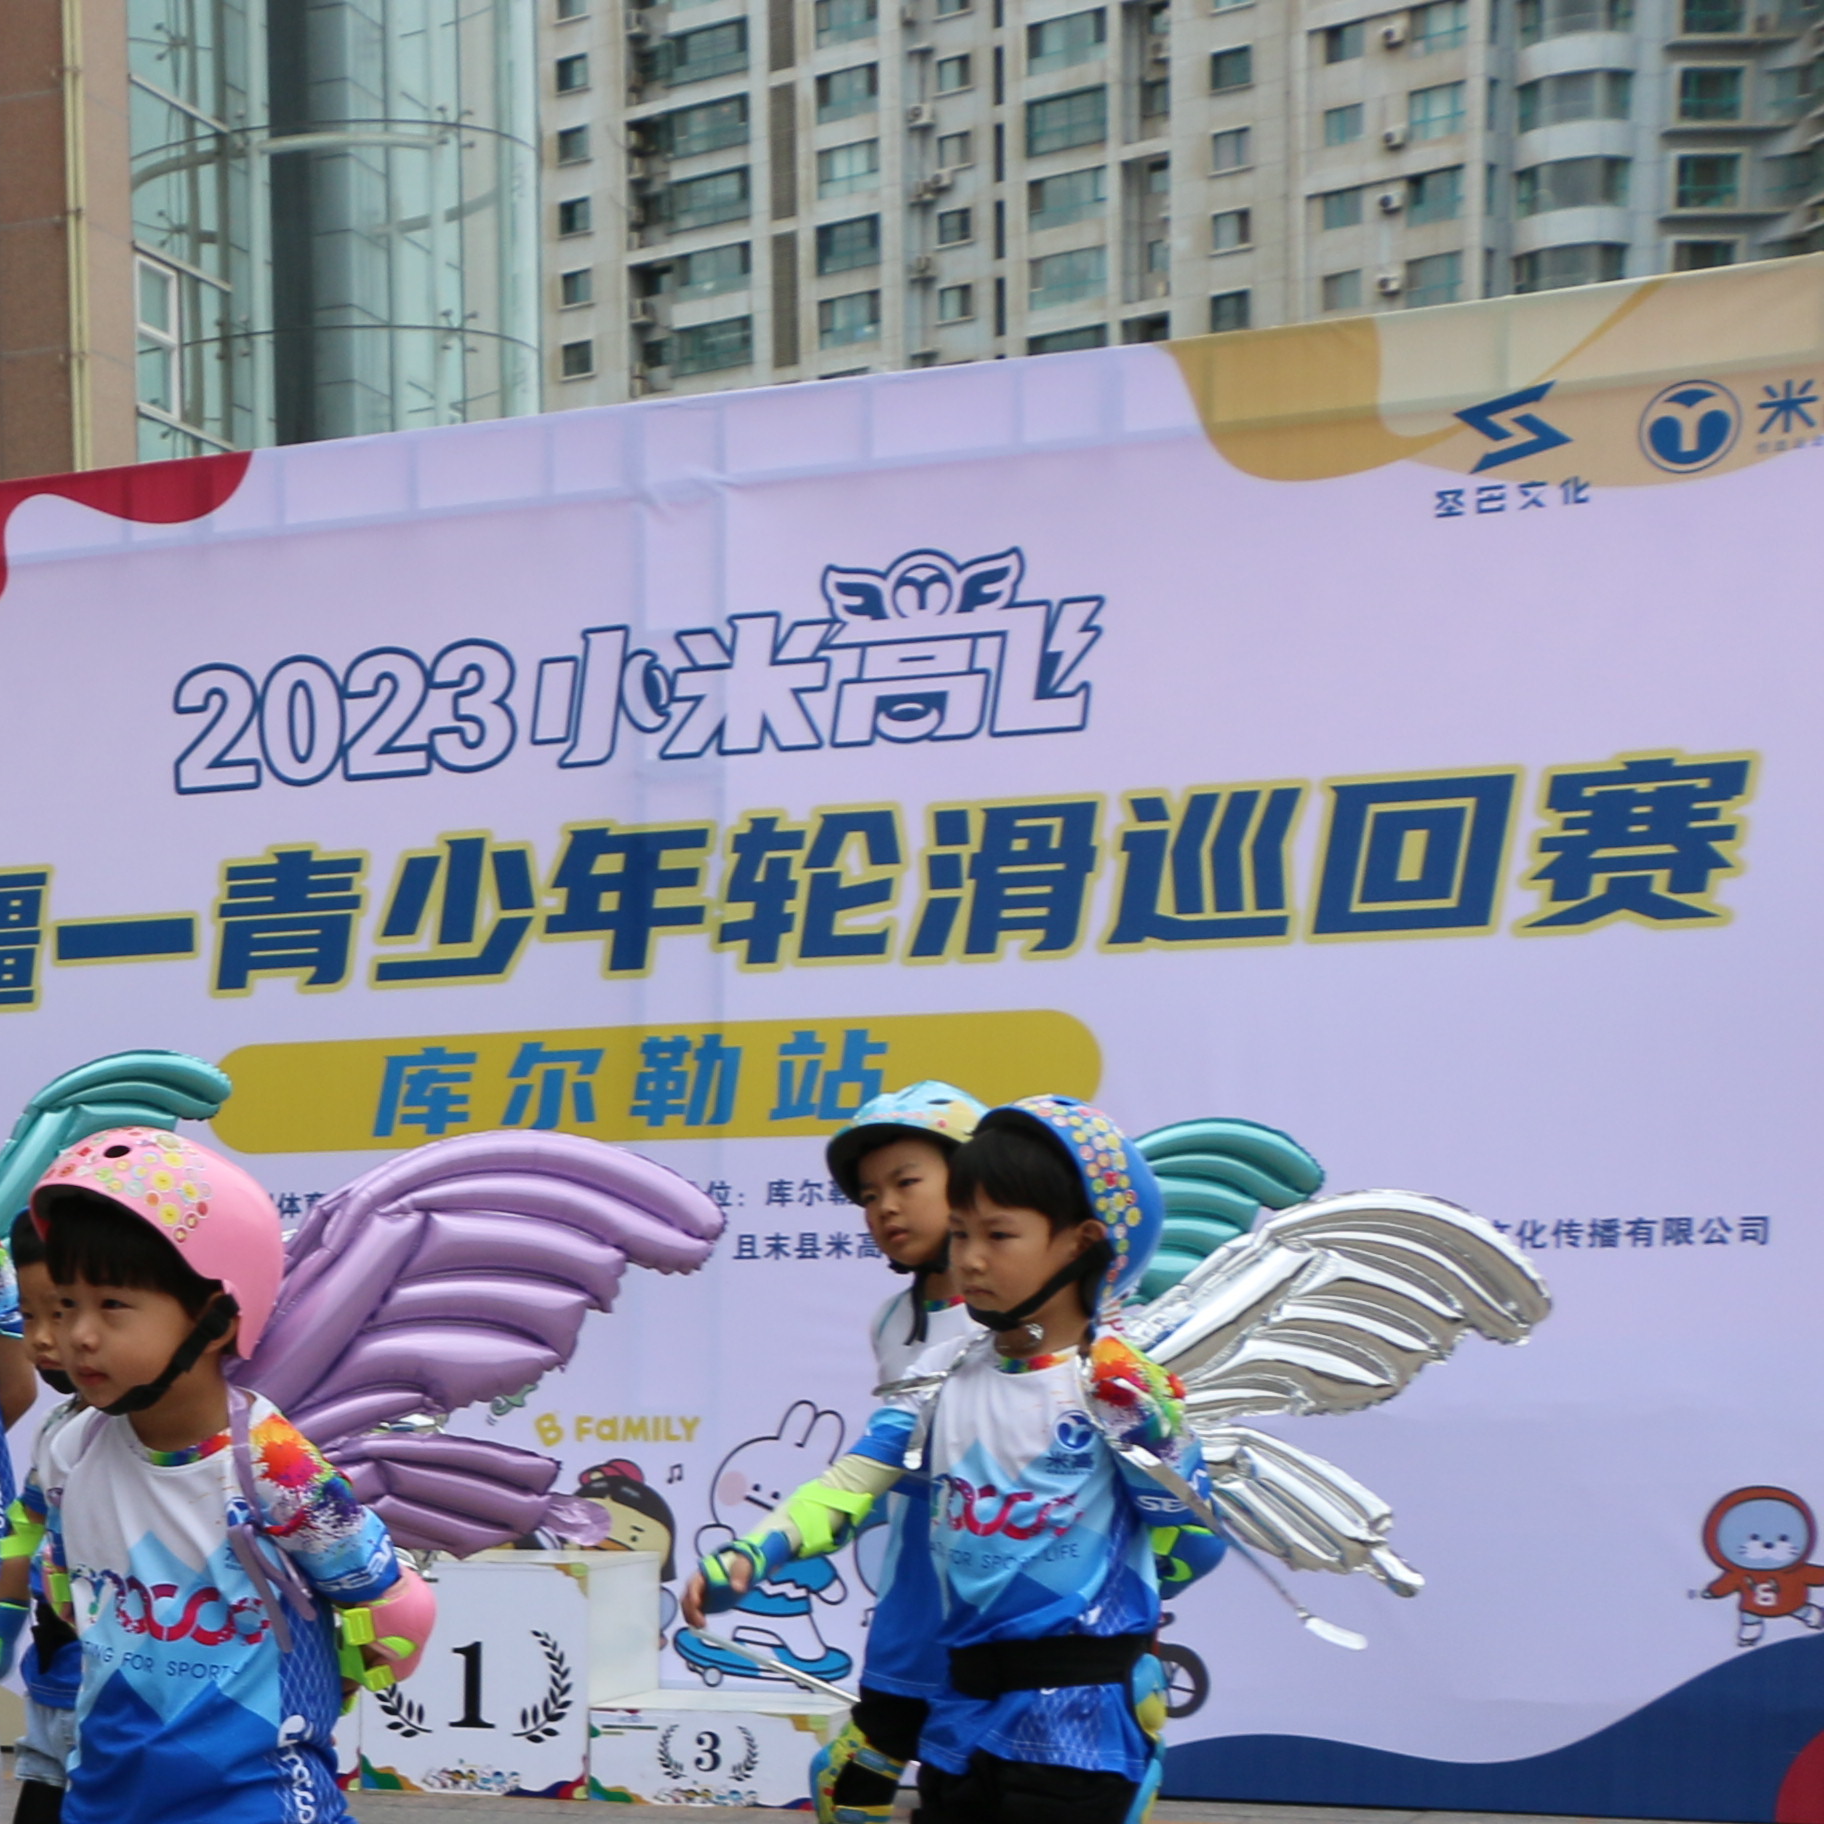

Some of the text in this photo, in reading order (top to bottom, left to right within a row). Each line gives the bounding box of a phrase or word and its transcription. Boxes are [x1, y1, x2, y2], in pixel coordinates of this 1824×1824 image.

[373, 1028, 890, 1138] 库尔勒站
[122, 1652, 153, 1674] FOR
[449, 1640, 495, 1730] 1
[694, 1730, 722, 1772] 3
